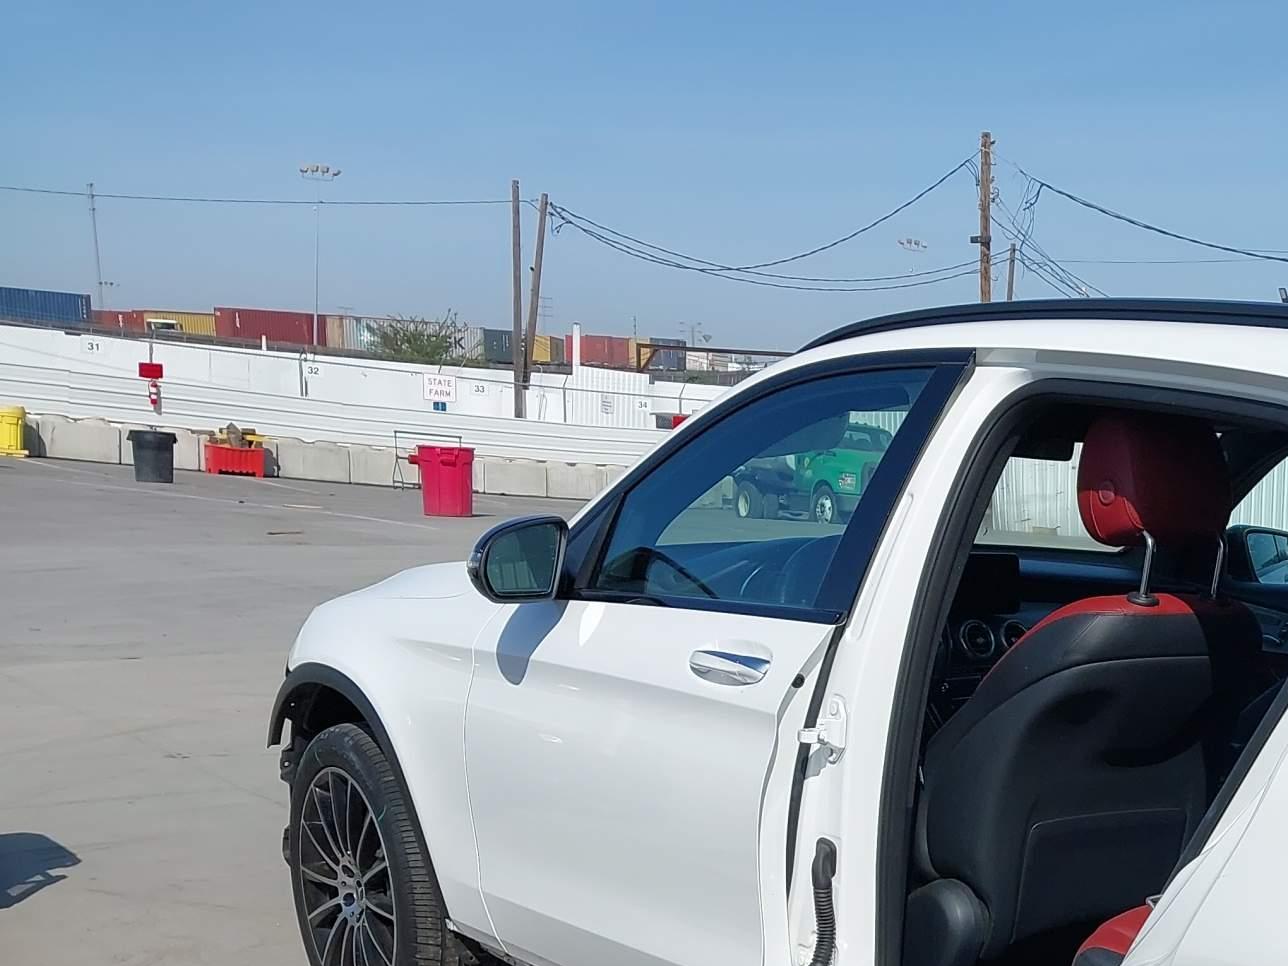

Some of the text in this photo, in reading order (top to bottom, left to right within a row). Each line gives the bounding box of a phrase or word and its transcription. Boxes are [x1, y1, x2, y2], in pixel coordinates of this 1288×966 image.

[87, 342, 100, 351] 31
[307, 366, 320, 375] 32
[427, 378, 452, 387] STATE
[429, 389, 451, 397] FARM
[474, 385, 485, 393] 33
